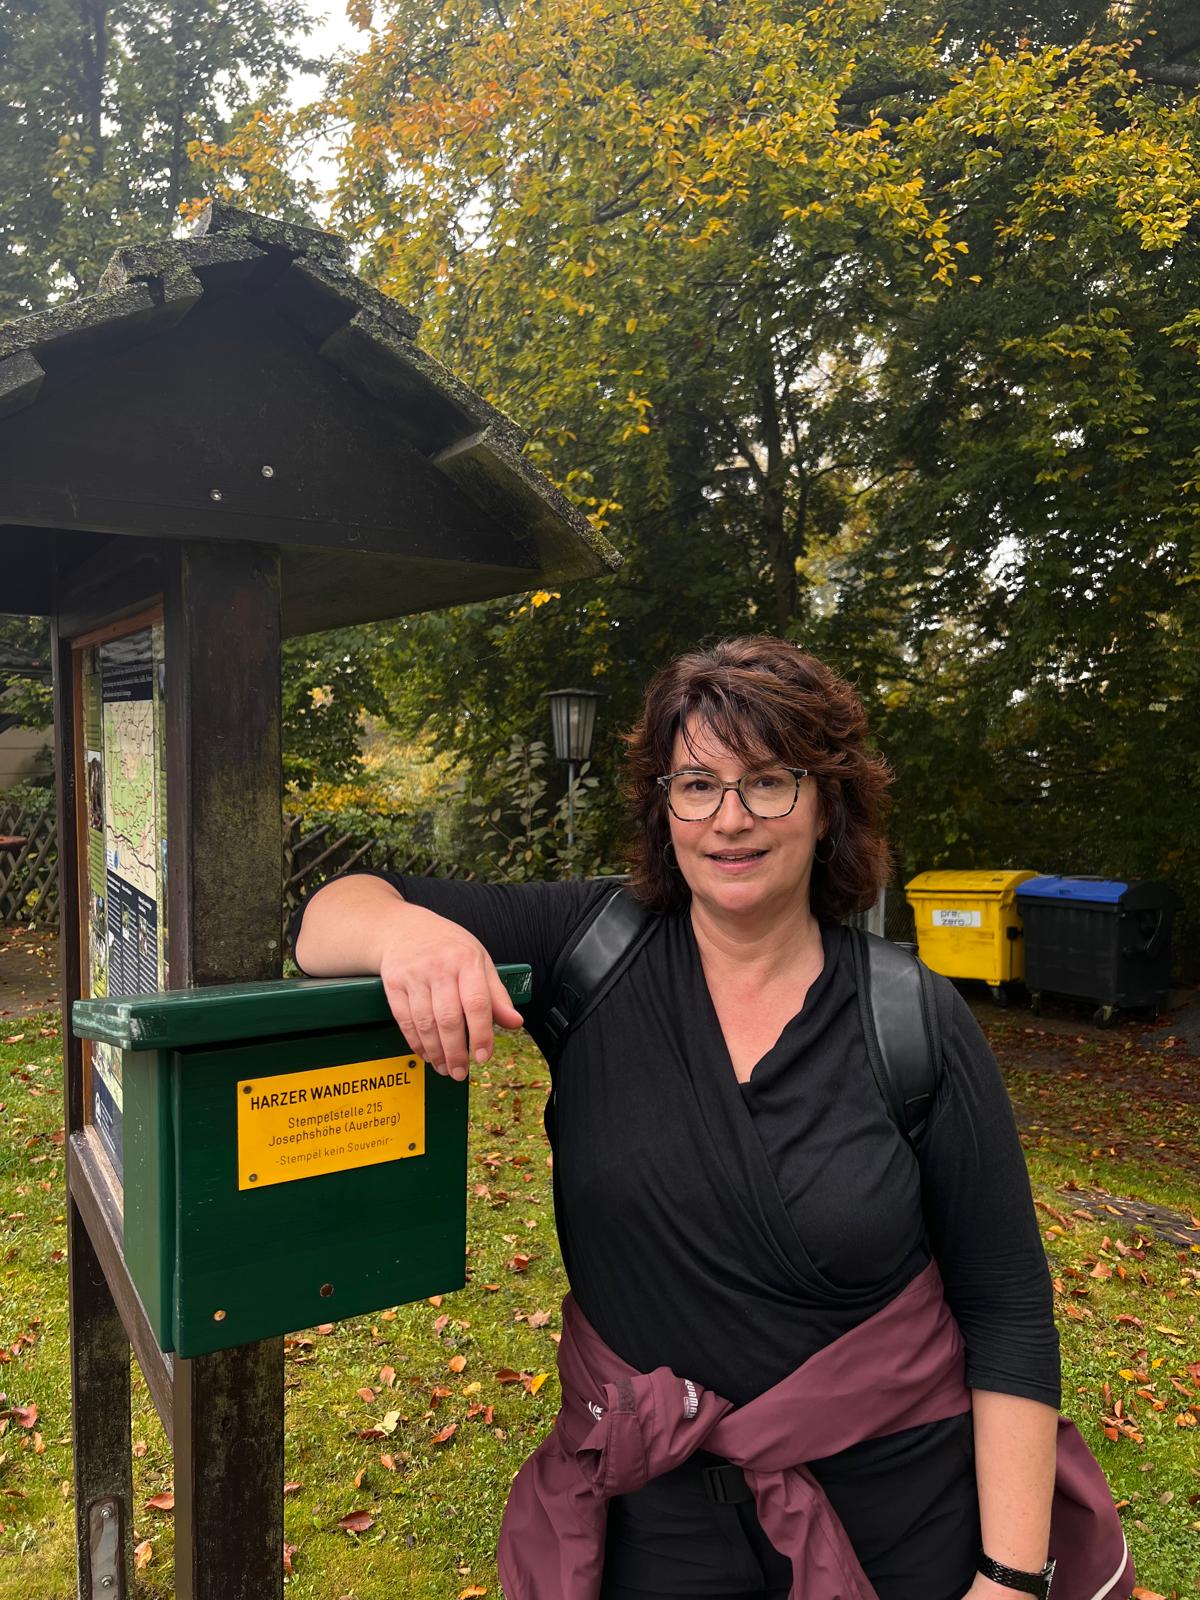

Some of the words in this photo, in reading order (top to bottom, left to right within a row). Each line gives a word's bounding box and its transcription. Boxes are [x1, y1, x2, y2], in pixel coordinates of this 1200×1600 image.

[942, 918, 965, 926] zero
[251, 1089, 307, 1111] HARZER
[311, 1072, 411, 1100] WANDERNADEL
[288, 1104, 364, 1129] Stempelstelle
[366, 1101, 383, 1115] 215
[268, 1125, 342, 1147] Josephshöhe
[344, 1112, 401, 1133] (Auerberg)
[324, 1146, 345, 1158] kein
